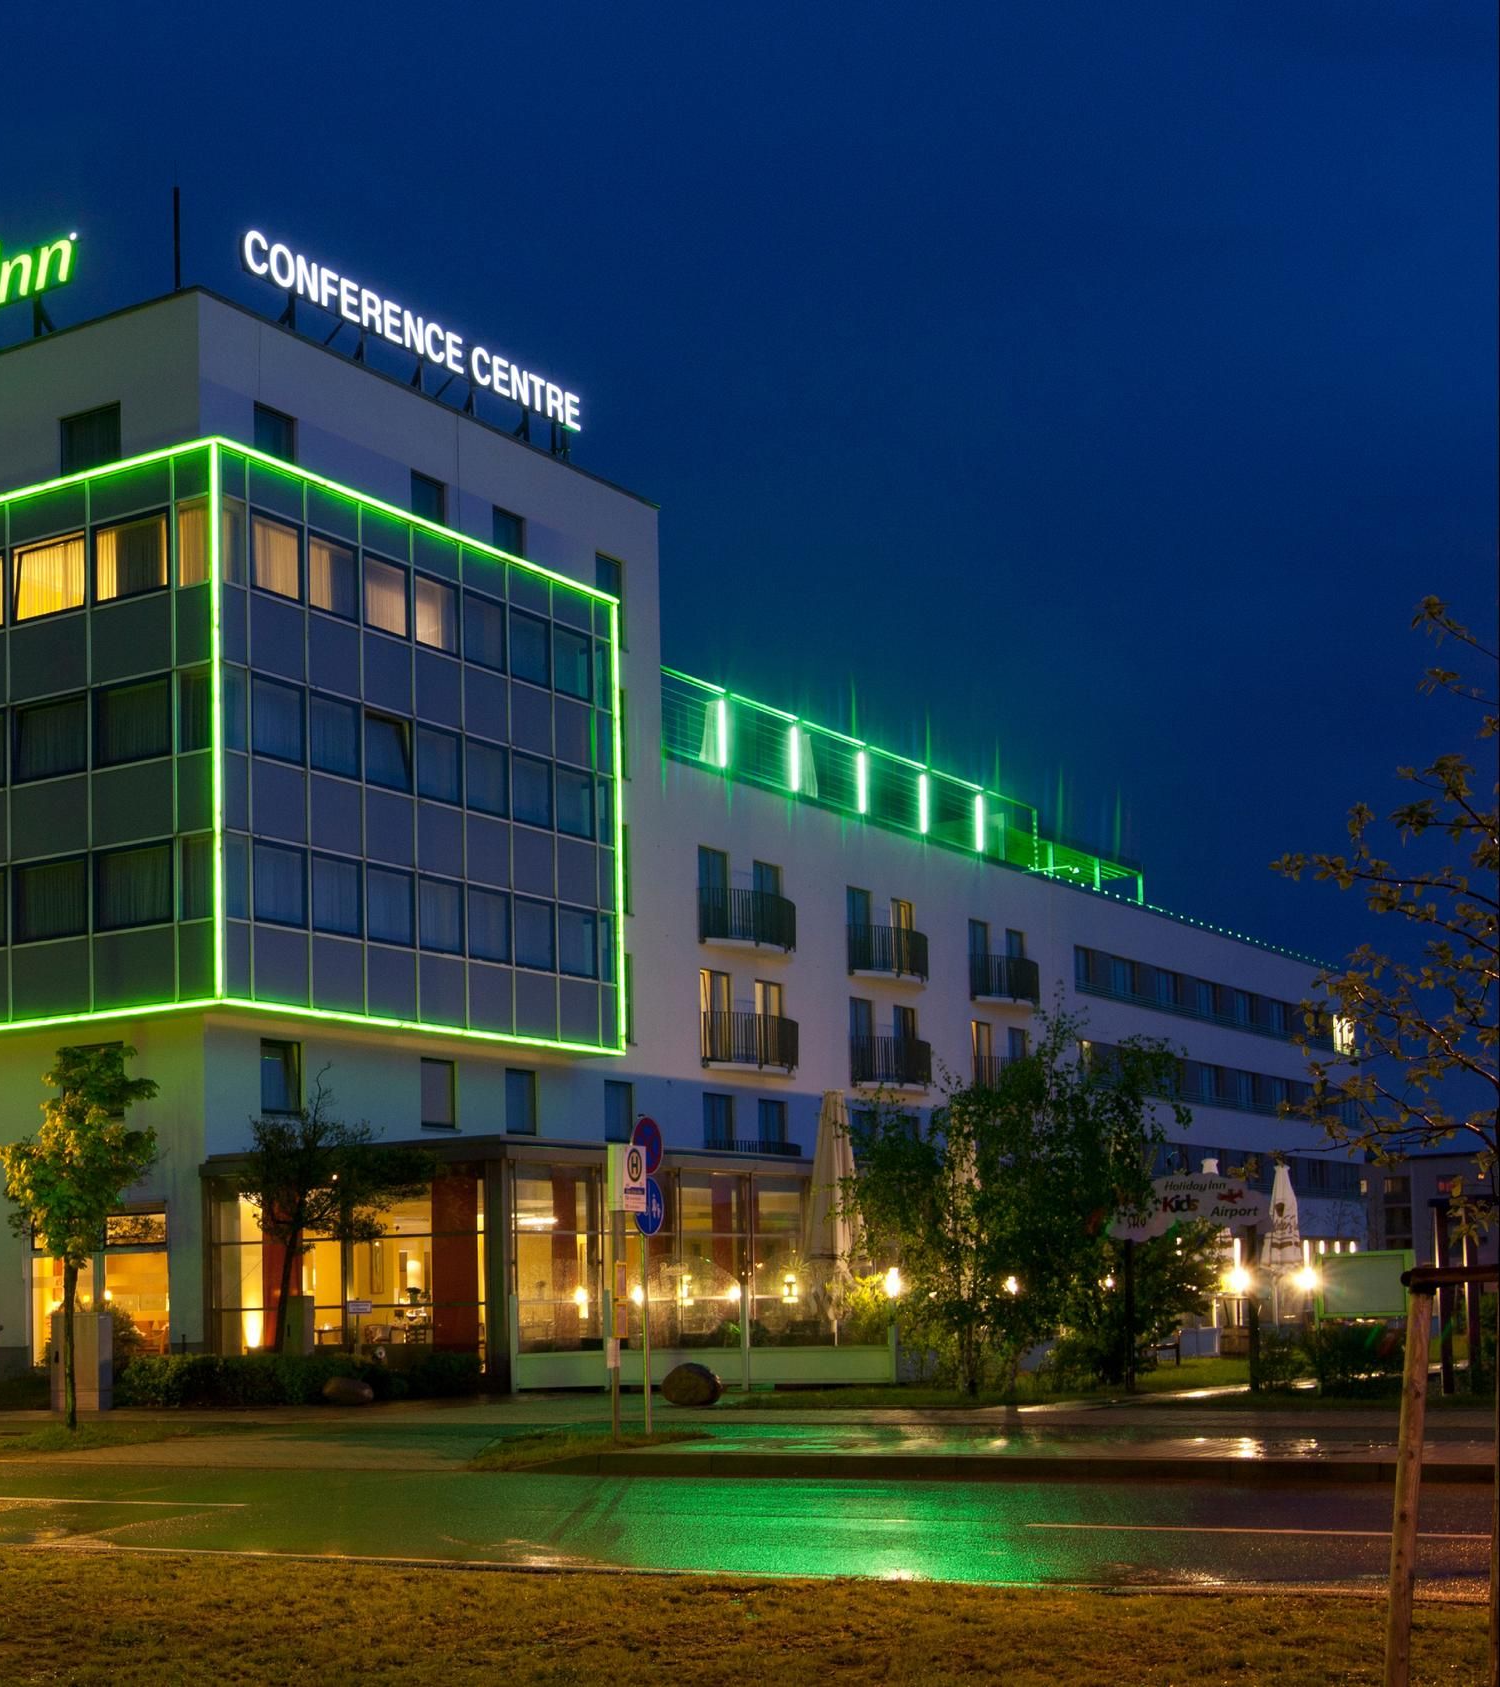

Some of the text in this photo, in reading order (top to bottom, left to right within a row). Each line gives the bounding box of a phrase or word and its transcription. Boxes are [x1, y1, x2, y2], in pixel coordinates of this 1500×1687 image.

[243, 229, 582, 432] CONFERENCE CENTRE
[1164, 1180, 1207, 1192] Holiday
[1162, 1194, 1200, 1213] Kids
[1211, 1206, 1258, 1219] Airport
